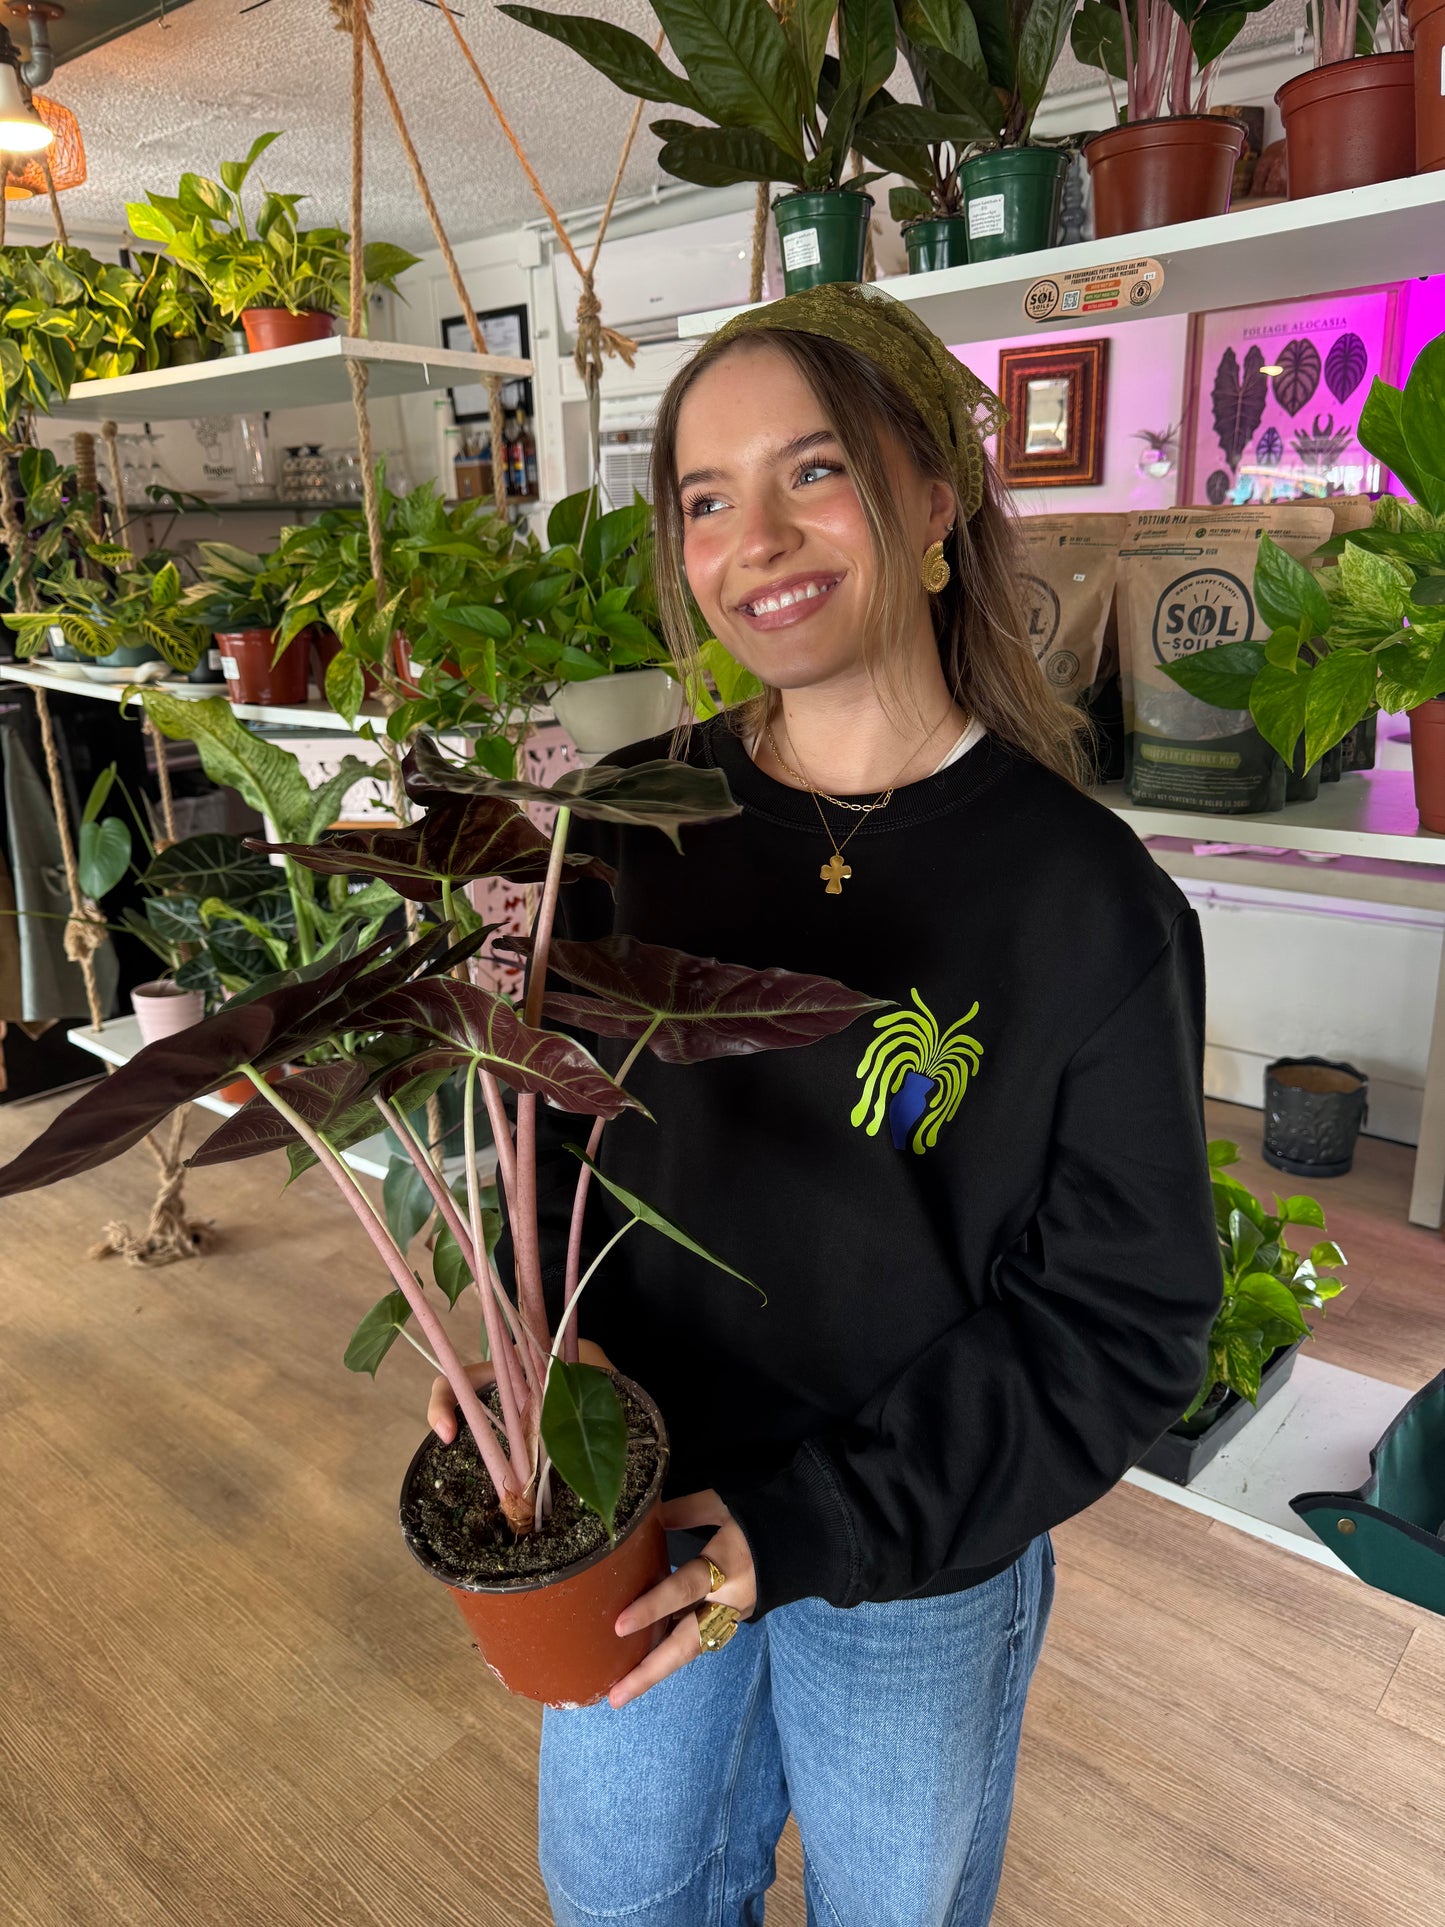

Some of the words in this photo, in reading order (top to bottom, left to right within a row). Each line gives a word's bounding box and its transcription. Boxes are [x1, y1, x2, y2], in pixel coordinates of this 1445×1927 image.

[1072, 269, 1098, 280] PERFORMANCE
[1096, 274, 1109, 282] PLANT
[1030, 292, 1055, 305] SOL
[1243, 324, 1287, 336] FOLIAGE
[1292, 317, 1346, 331] ALOCASIA
[1138, 515, 1170, 525] POTTING
[1171, 514, 1189, 524] MIX
[1176, 583, 1193, 596] GROW
[1166, 603, 1238, 636] SOL
[1185, 751, 1216, 763] CHUNKY
[1218, 754, 1235, 766] MIX
